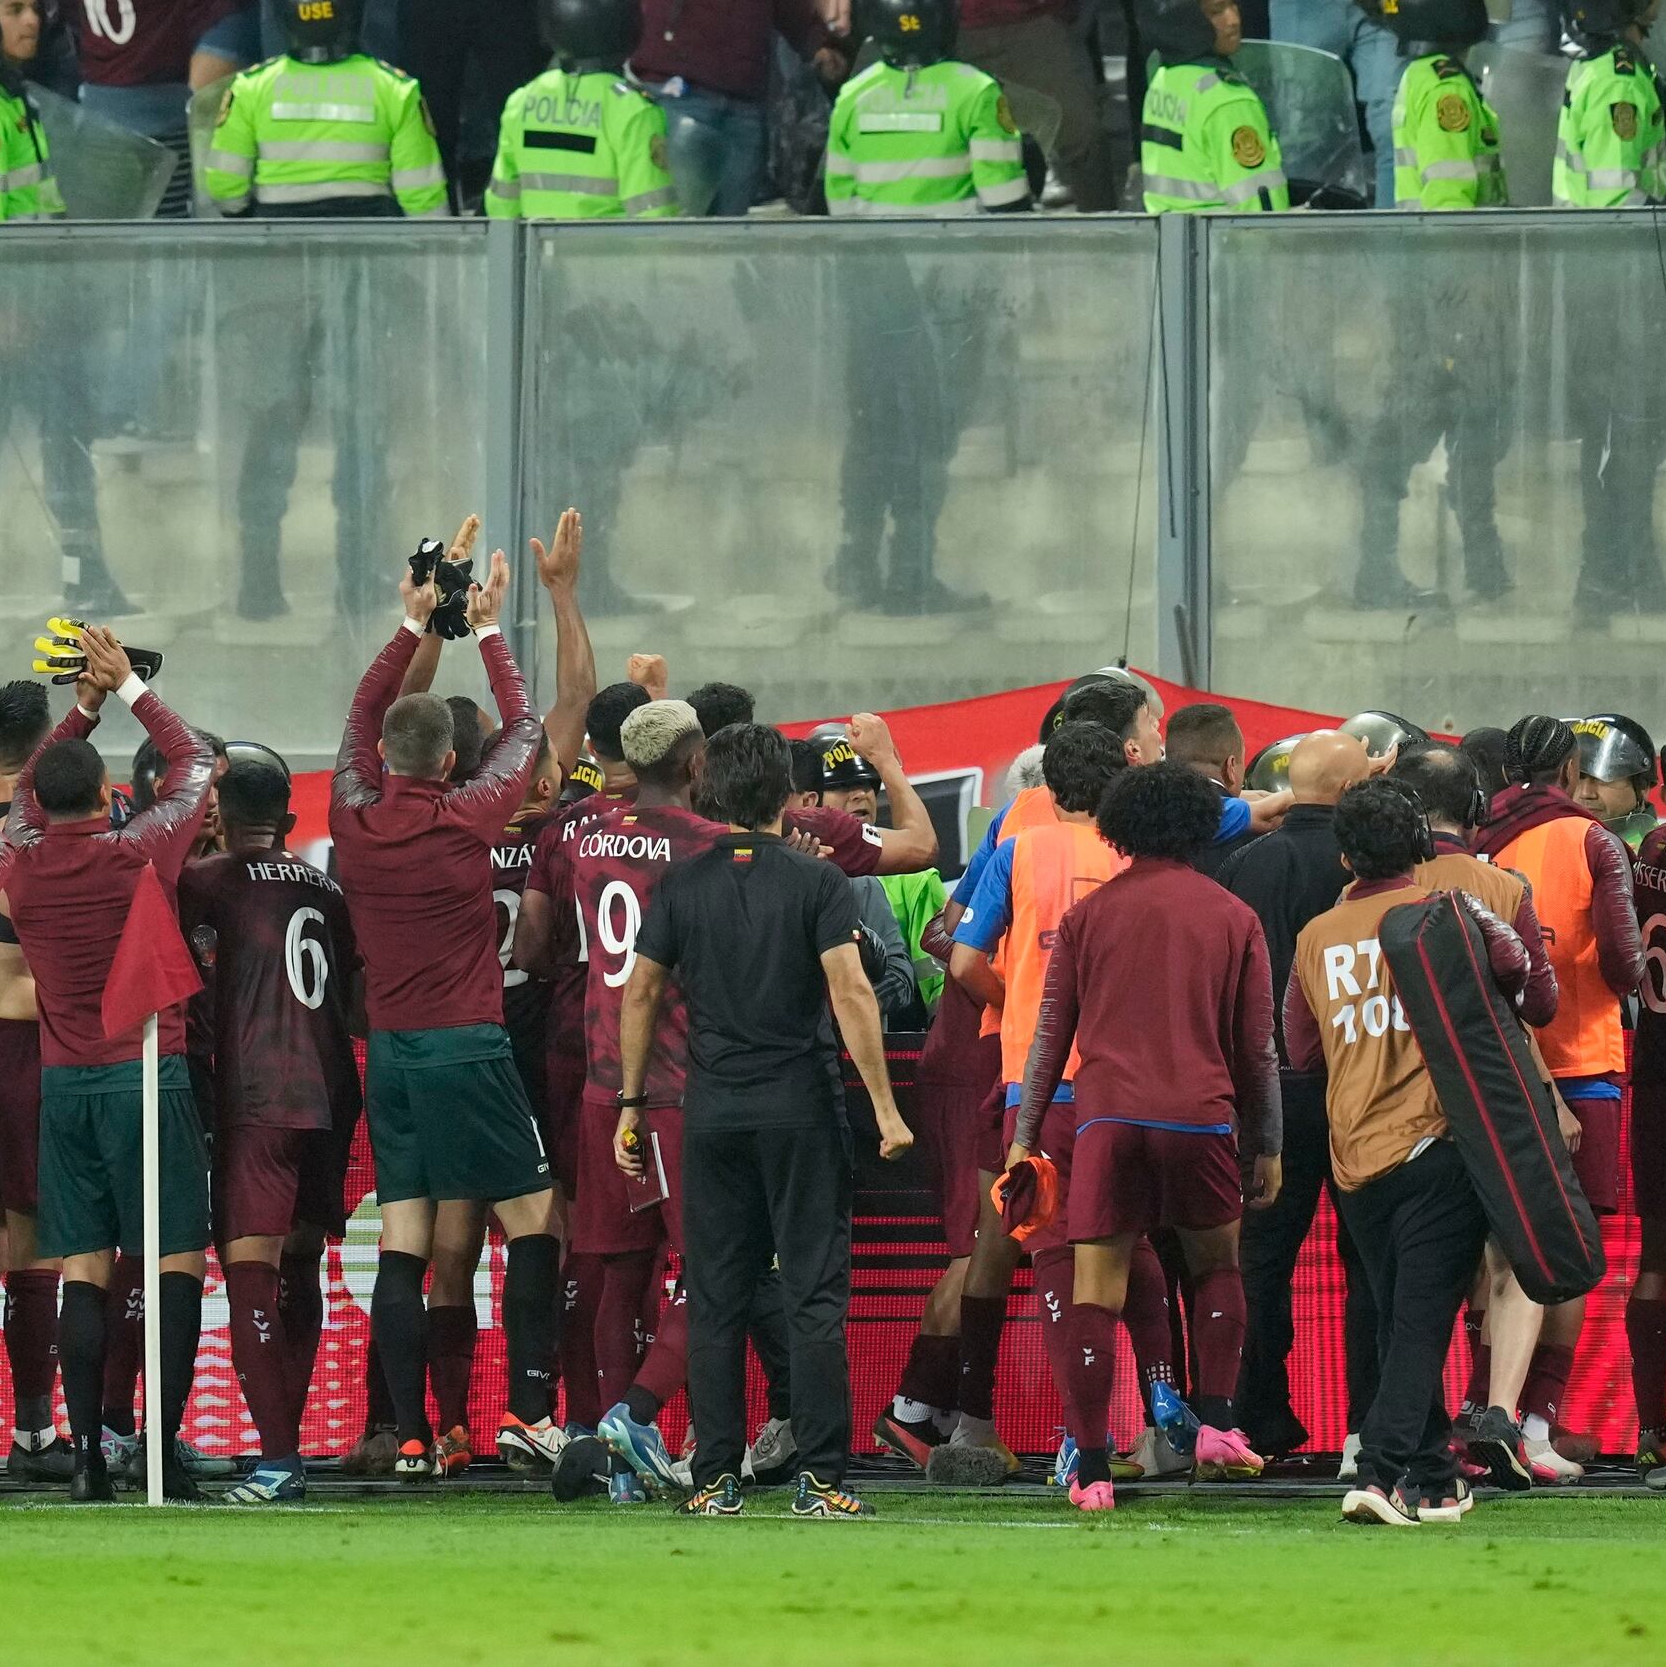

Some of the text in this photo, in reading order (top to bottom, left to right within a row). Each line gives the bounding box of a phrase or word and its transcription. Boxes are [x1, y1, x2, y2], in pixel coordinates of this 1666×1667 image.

[297, 0, 334, 22] USE
[569, 763, 604, 791] LICIA
[578, 829, 673, 863] CÓRDOVA
[245, 861, 343, 897] HERRERA
[596, 880, 643, 989] 9
[284, 906, 330, 1011] 6
[1323, 937, 1383, 1002] RT
